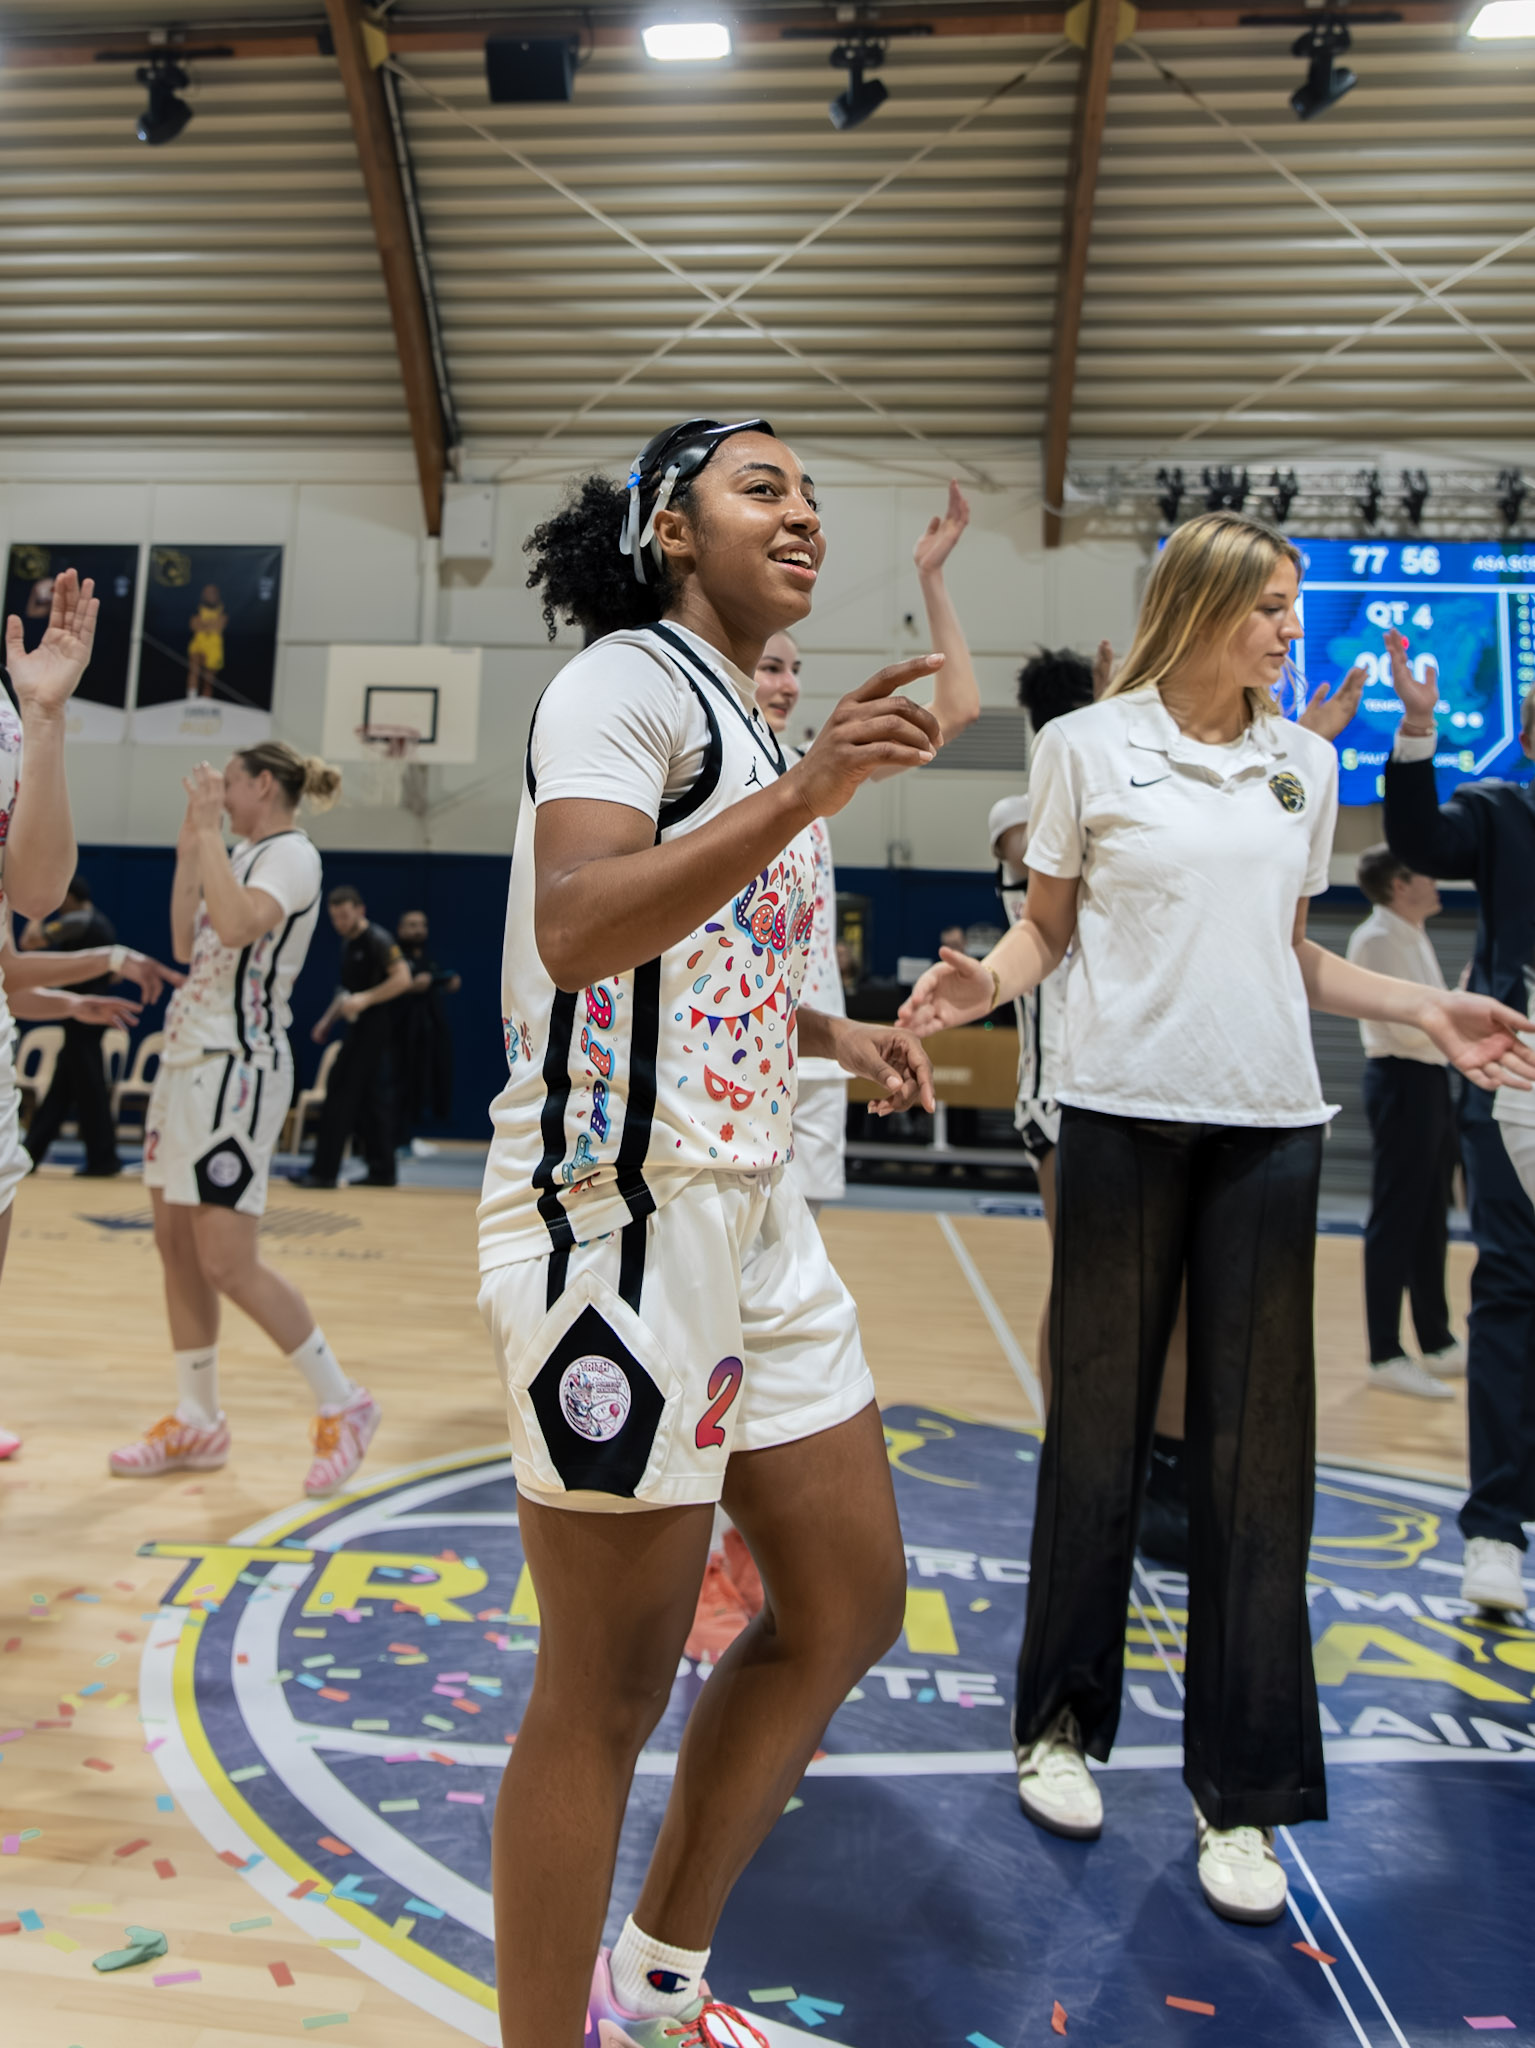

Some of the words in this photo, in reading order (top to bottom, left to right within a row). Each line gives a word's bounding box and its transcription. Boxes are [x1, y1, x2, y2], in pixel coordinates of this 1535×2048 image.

[1349, 545, 1389, 574] 77
[1401, 545, 1441, 575] 56
[1366, 601, 1409, 629] QT
[1412, 603, 1434, 630] 4
[580, 1361, 609, 1371] TRITH
[695, 1356, 743, 1449] 2
